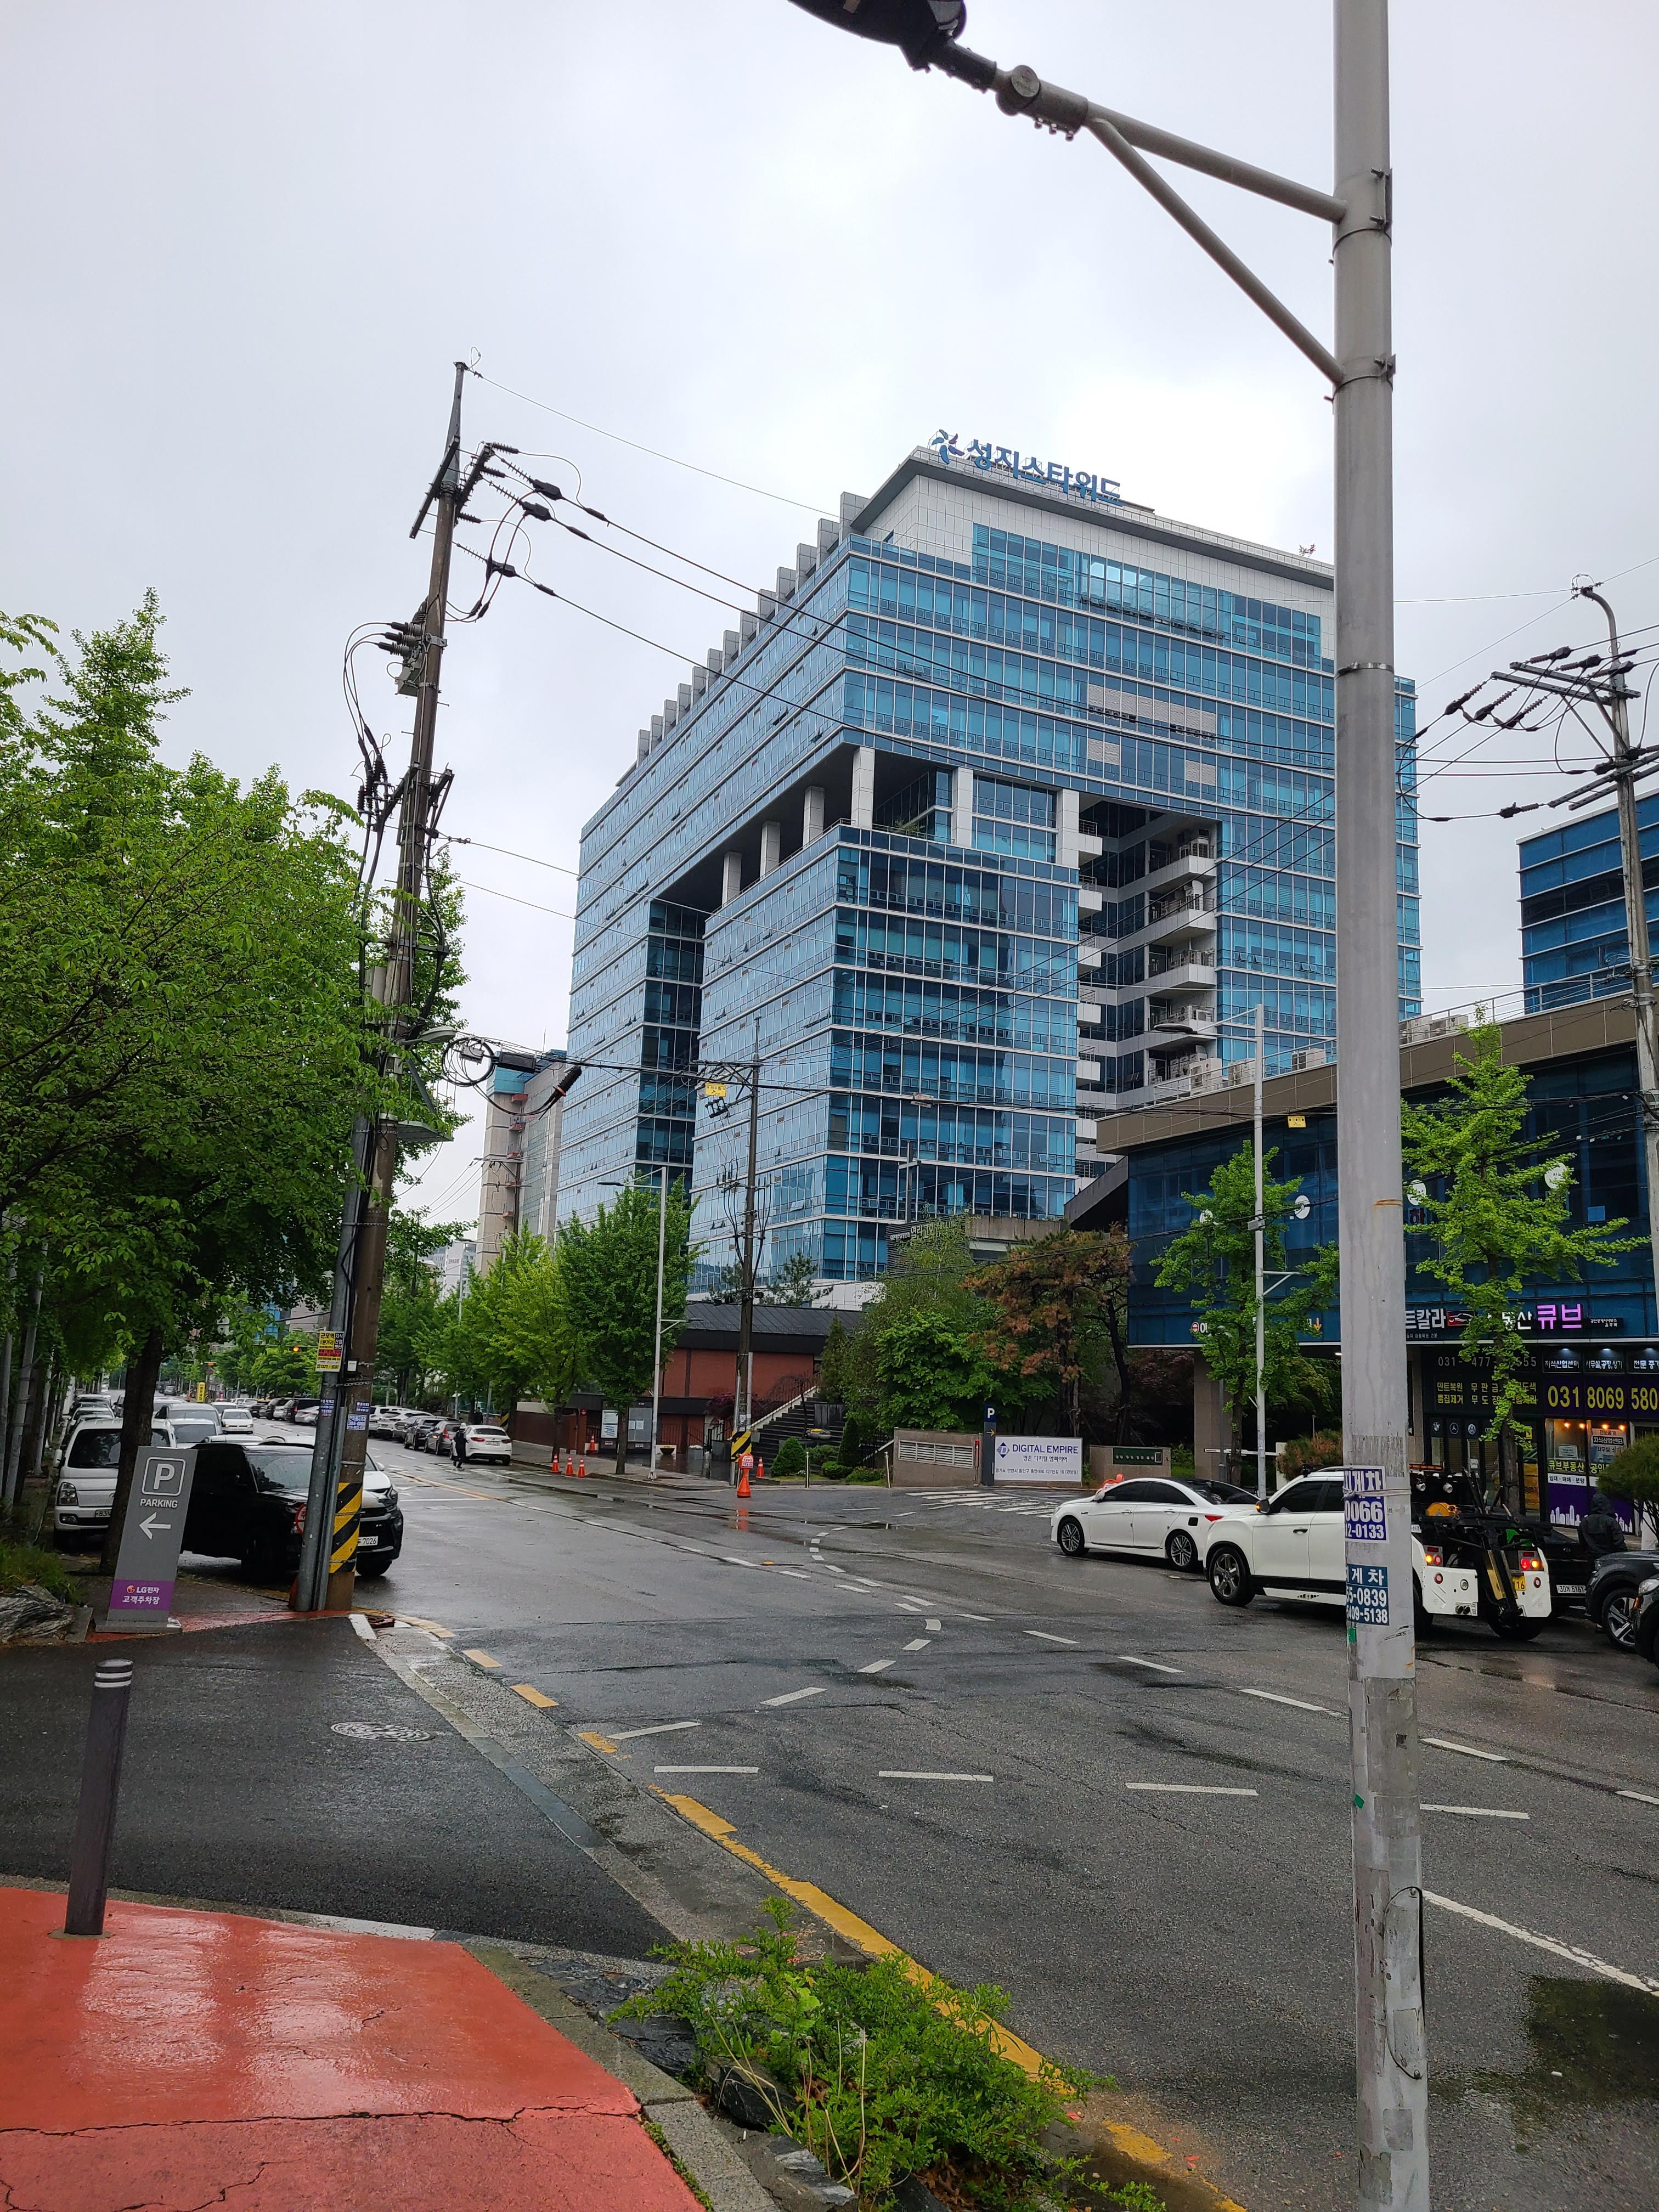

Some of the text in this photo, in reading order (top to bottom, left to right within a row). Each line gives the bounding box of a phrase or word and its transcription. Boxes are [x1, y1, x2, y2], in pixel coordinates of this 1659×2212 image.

[1537, 1304, 1582, 1330] 큐브
[1545, 1360, 1579, 1369] 지식산업센터
[1633, 1360, 1646, 1369] 전문
[1548, 1386, 1579, 1408] 031
[1587, 1386, 1624, 1409] 8069
[988, 1408, 995, 1419] P
[1012, 1444, 1079, 1454] DIGITAL EMPIRE
[1549, 1460, 1584, 1472] 큐브부동산
[154, 1463, 175, 1490] P
[140, 1498, 178, 1508] PARKING
[122, 1595, 160, 1605] 고객주차장
